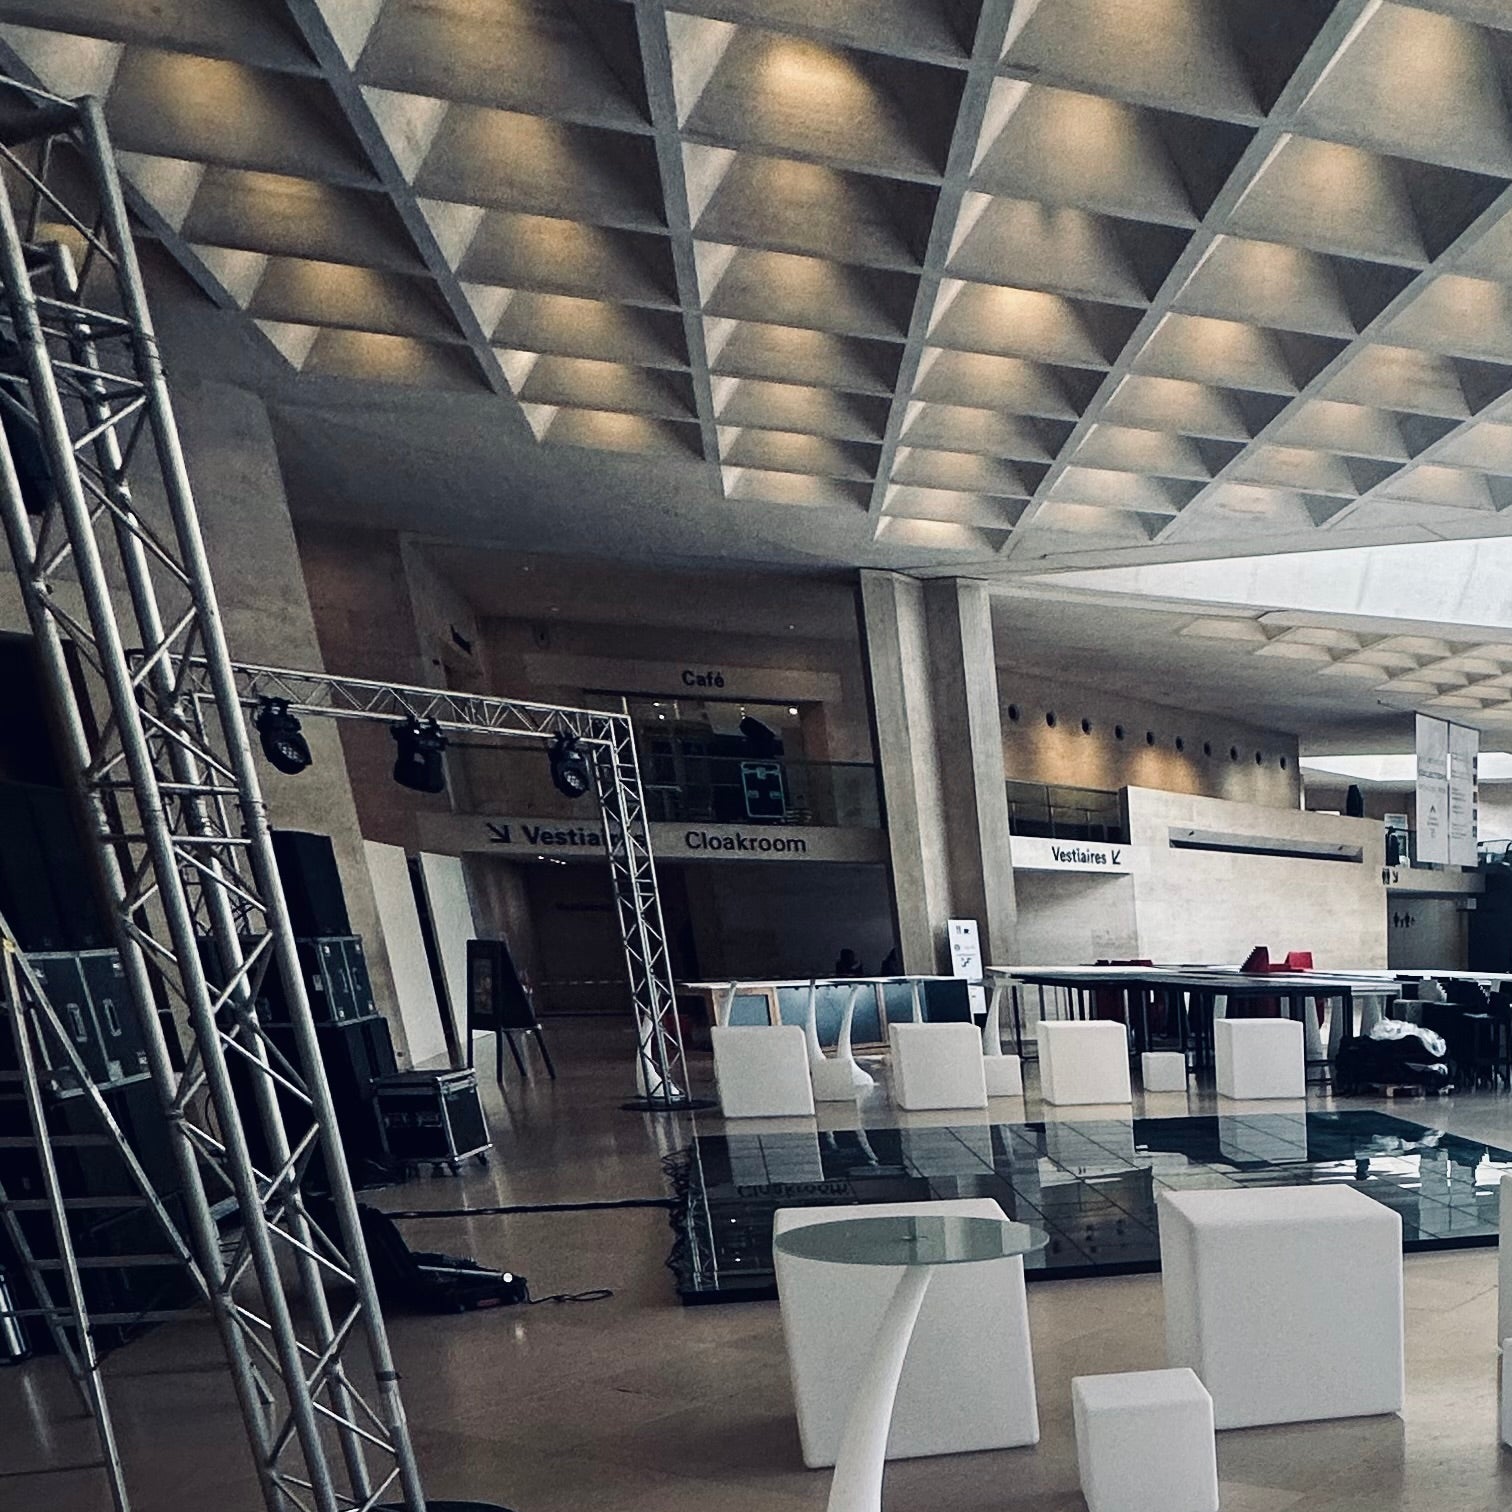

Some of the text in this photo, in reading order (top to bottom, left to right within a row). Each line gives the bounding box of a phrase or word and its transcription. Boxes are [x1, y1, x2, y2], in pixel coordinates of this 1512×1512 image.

[682, 670, 725, 688] Café
[685, 831, 807, 852] Cloakroom
[1051, 845, 1108, 865] Vestiaires
